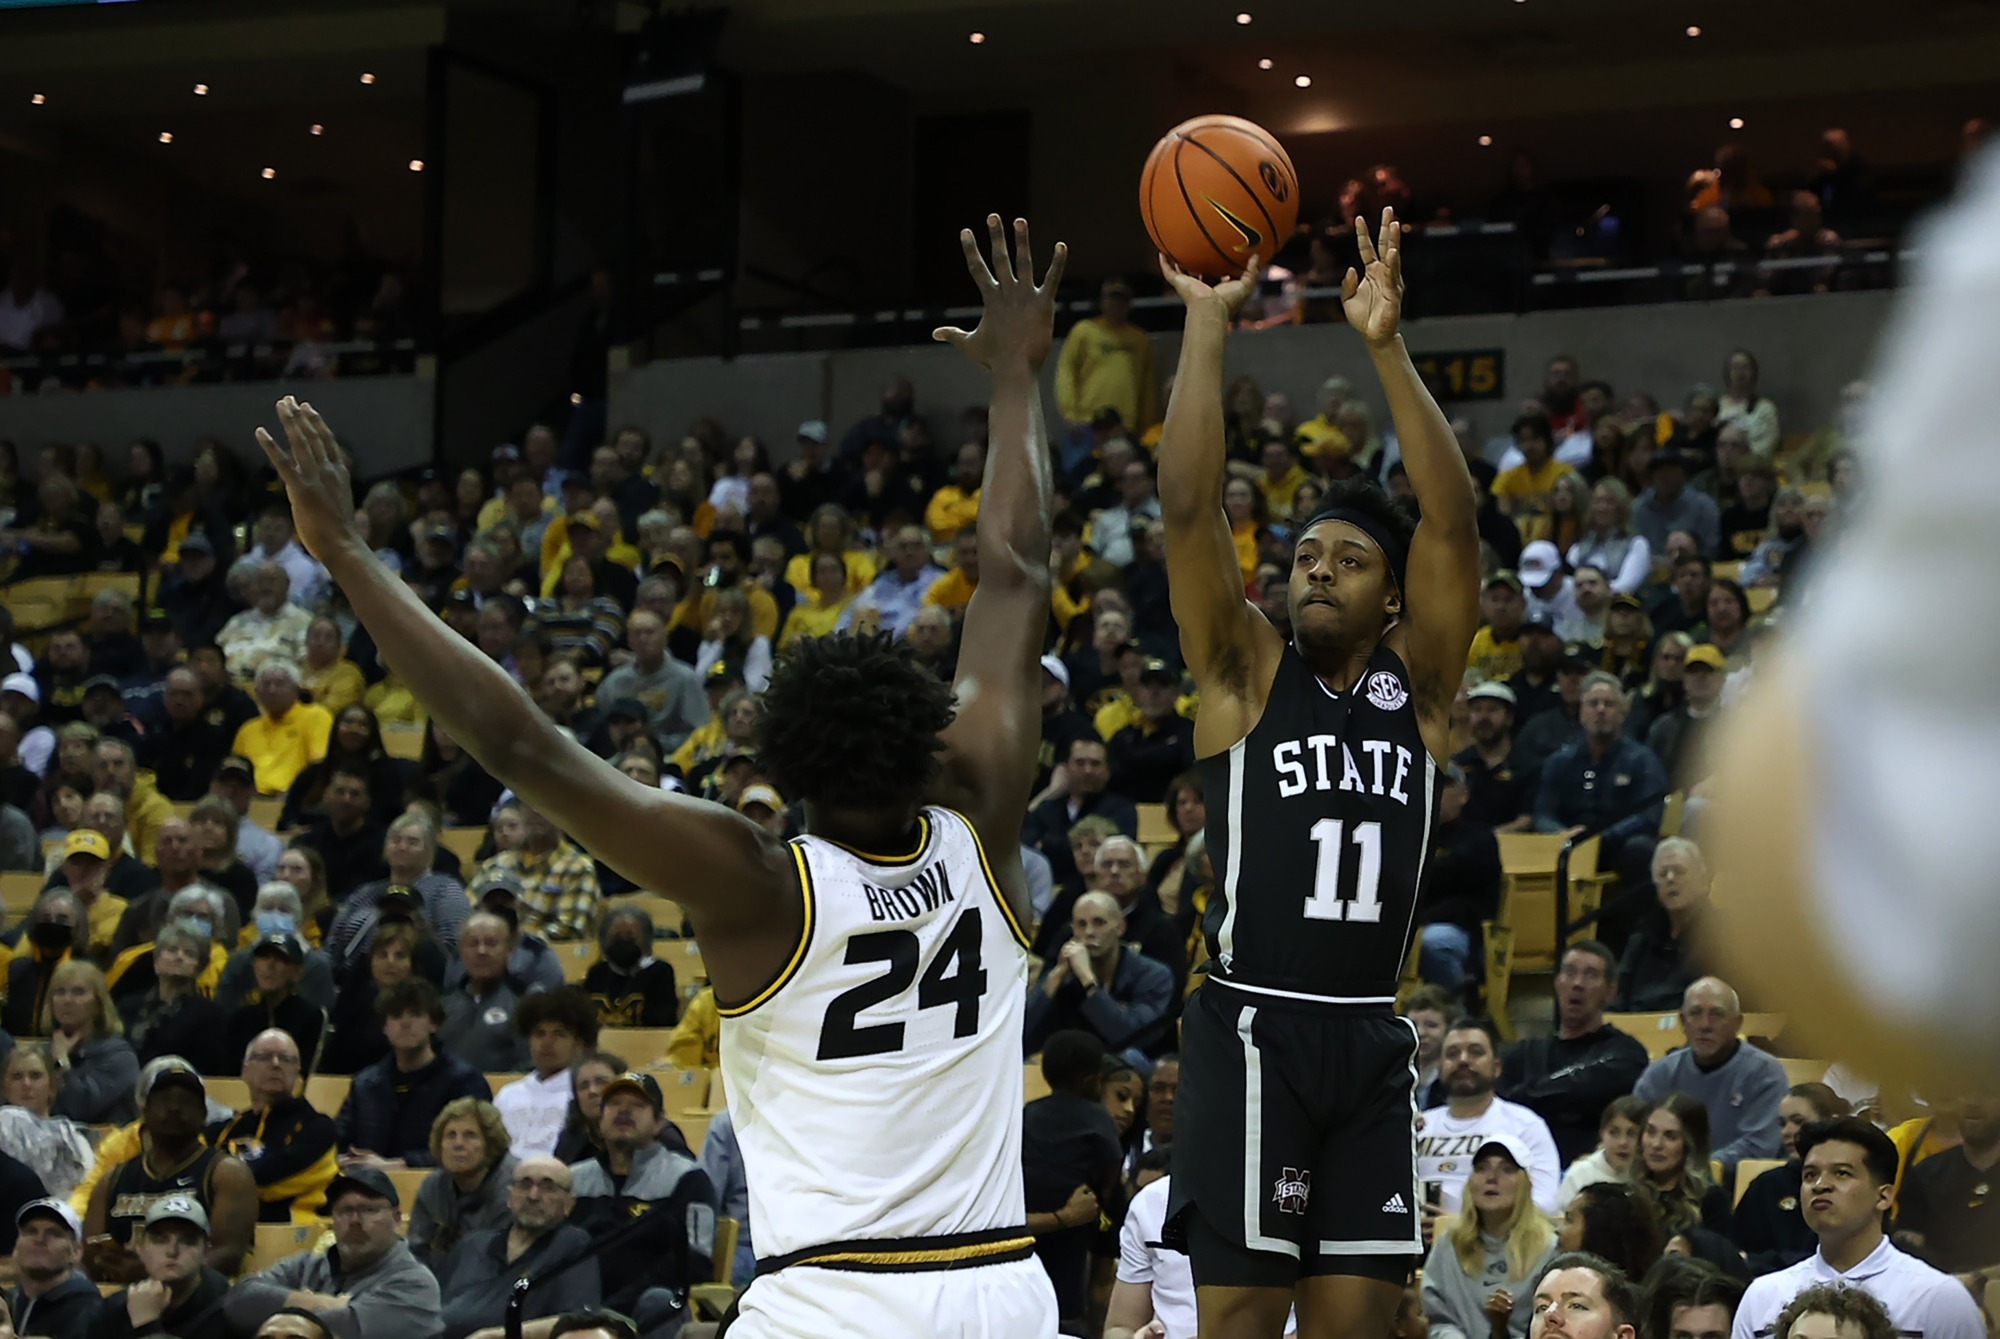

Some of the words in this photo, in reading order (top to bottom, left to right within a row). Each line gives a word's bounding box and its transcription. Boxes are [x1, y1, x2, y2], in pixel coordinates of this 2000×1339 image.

[1370, 674, 1399, 701] SEC
[1273, 734, 1412, 806] STATE
[863, 859, 955, 921] BROWN
[1303, 817, 1383, 922] 11
[816, 906, 988, 1061] 24
[1382, 1205, 1408, 1214] adidas
